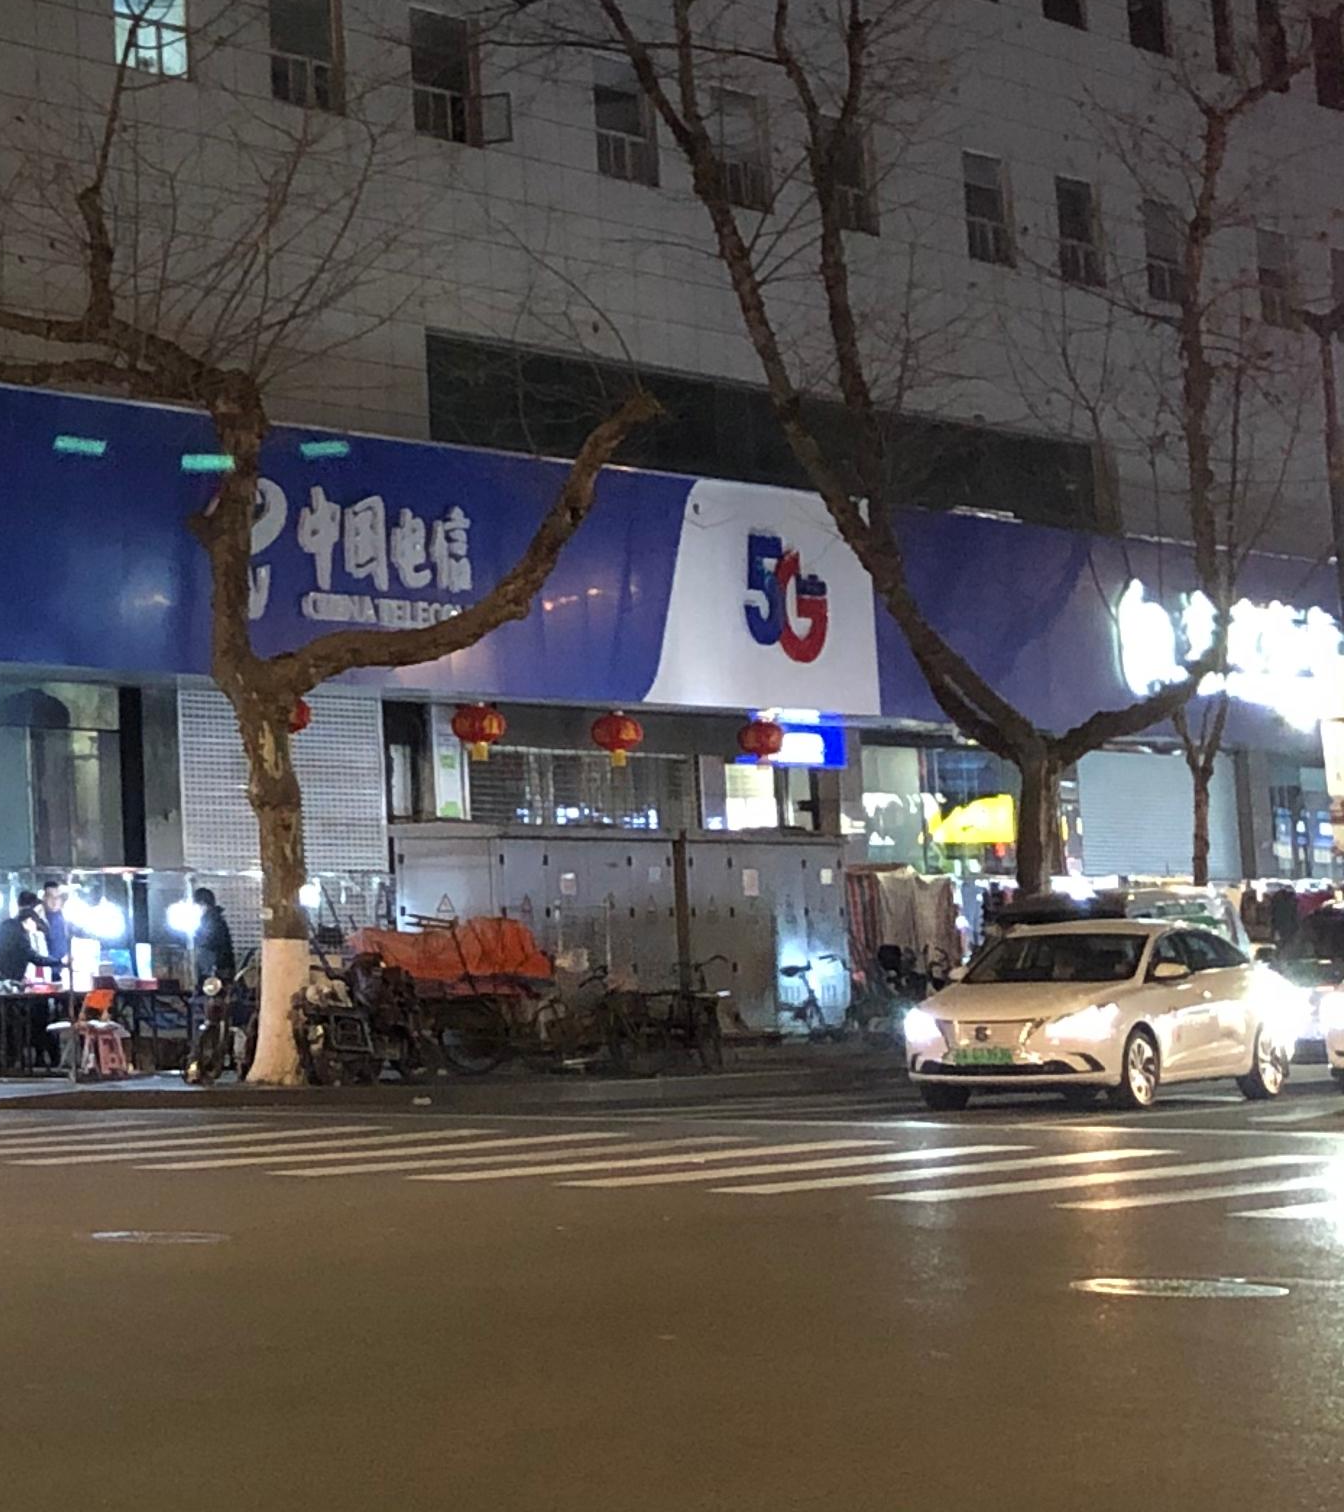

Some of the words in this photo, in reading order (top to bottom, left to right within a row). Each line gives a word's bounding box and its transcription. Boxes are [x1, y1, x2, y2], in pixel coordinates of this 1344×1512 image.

[297, 485, 472, 592] 中国电信
[744, 530, 829, 664] 5G
